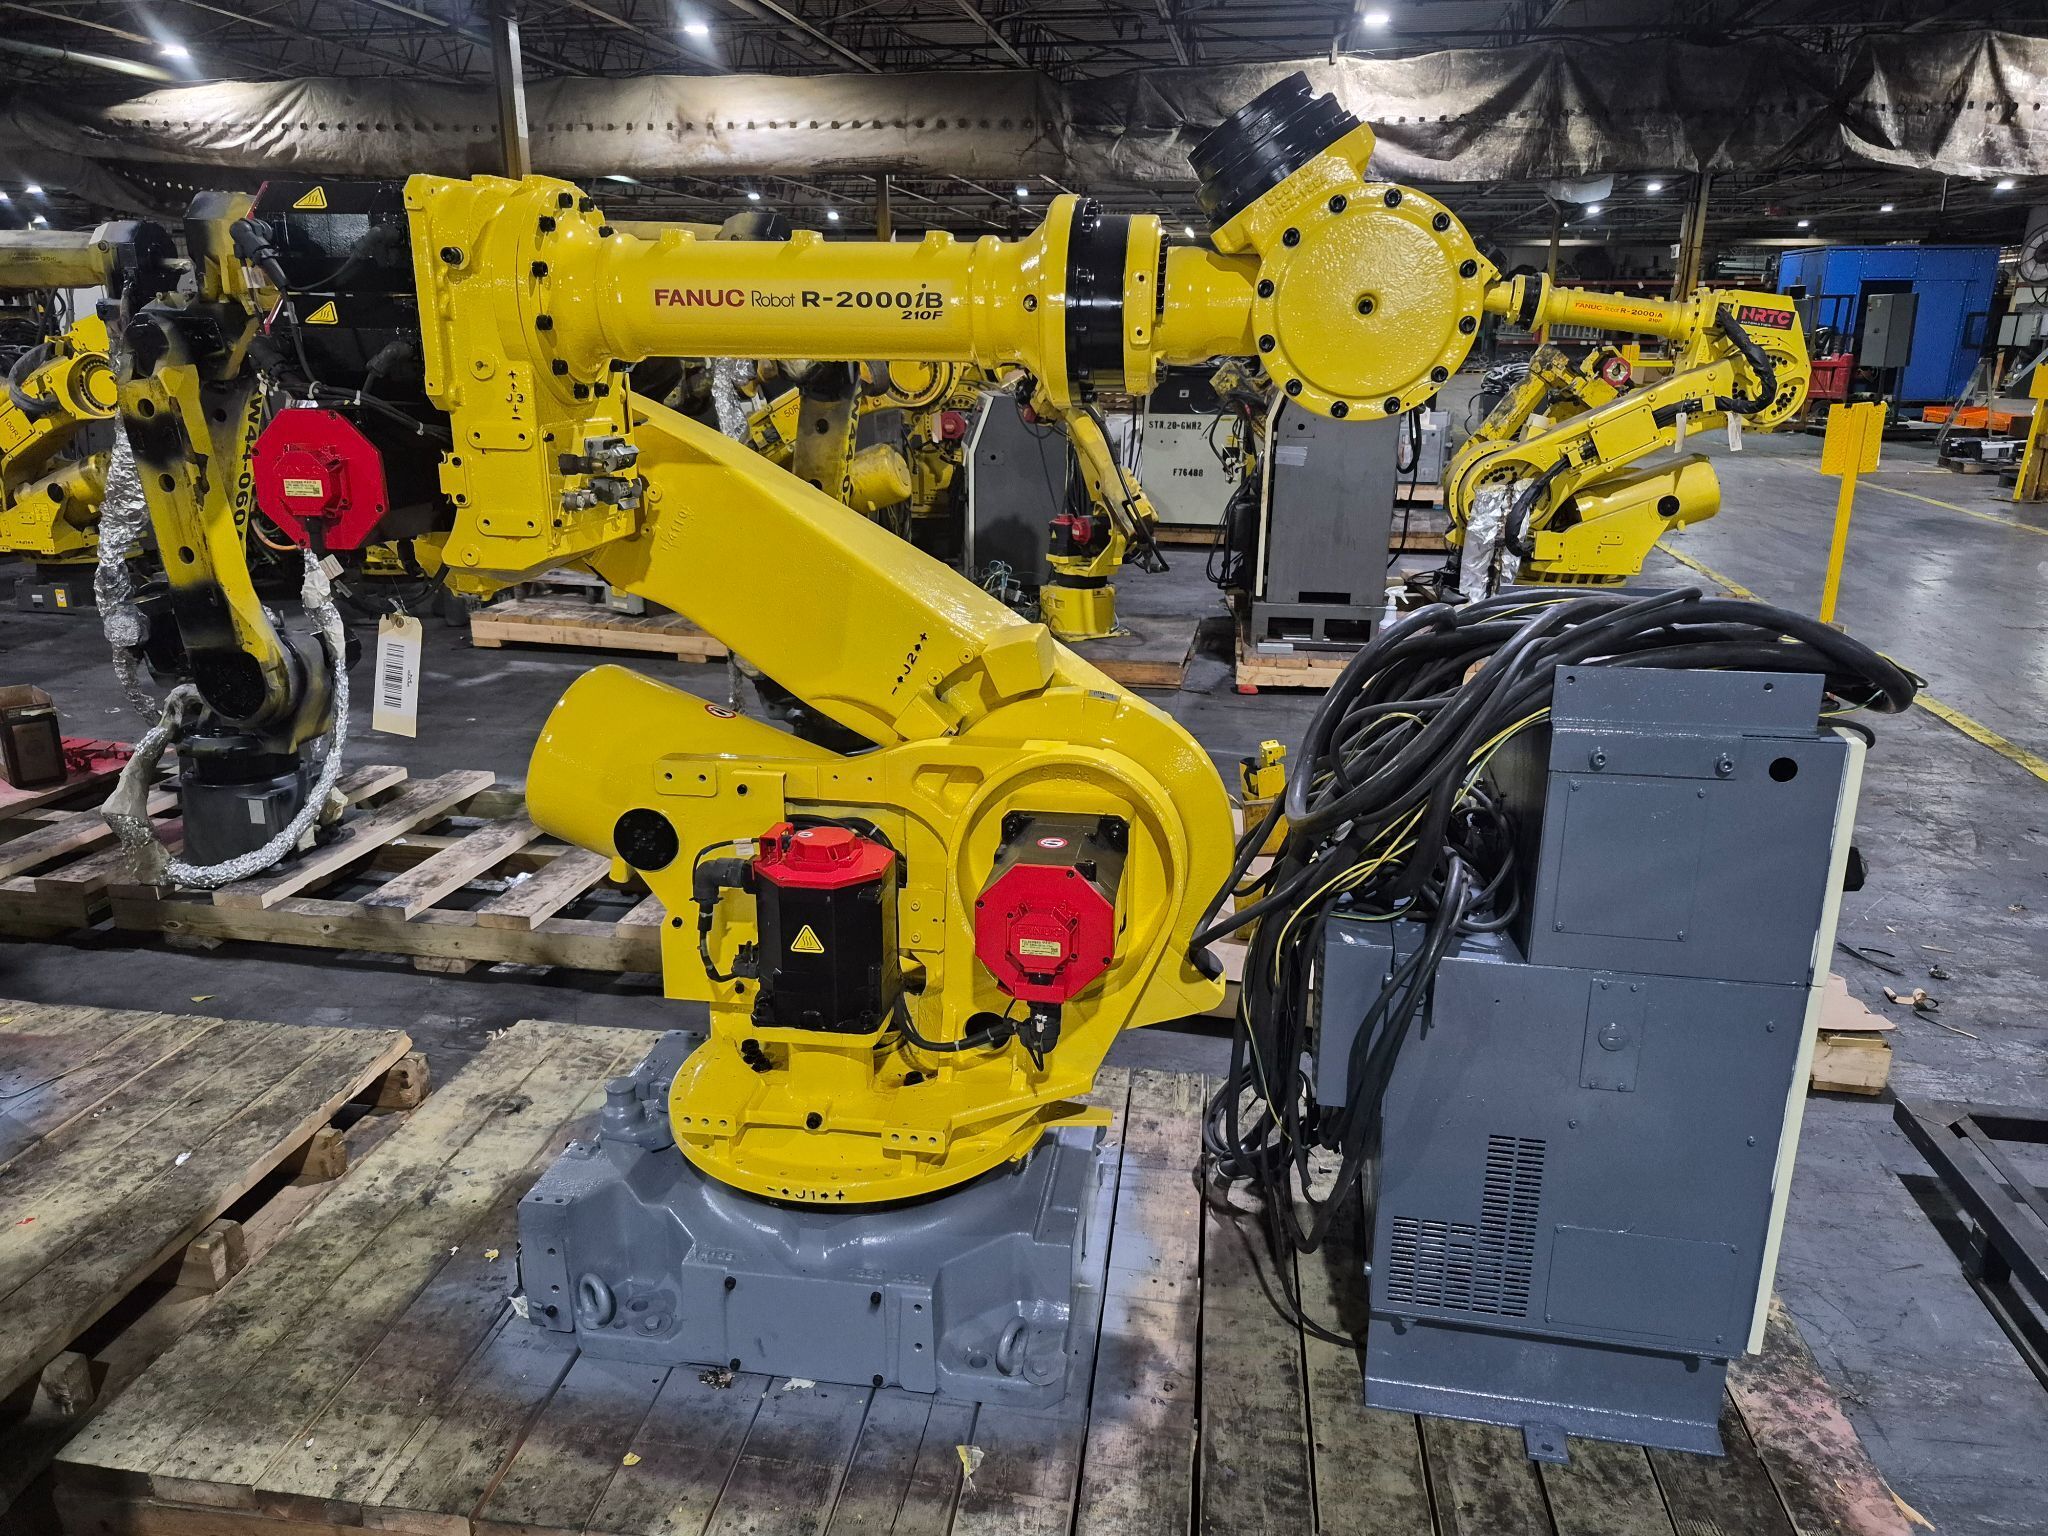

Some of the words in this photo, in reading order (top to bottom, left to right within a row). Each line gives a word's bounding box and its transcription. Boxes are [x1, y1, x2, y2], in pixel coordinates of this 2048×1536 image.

[654, 288, 745, 308] FANUC
[751, 290, 796, 308] Robot
[801, 283, 944, 309] R-2000iB
[1575, 302, 1602, 311] FANUC
[901, 310, 944, 321] 210F
[1741, 307, 1791, 325] NRTC
